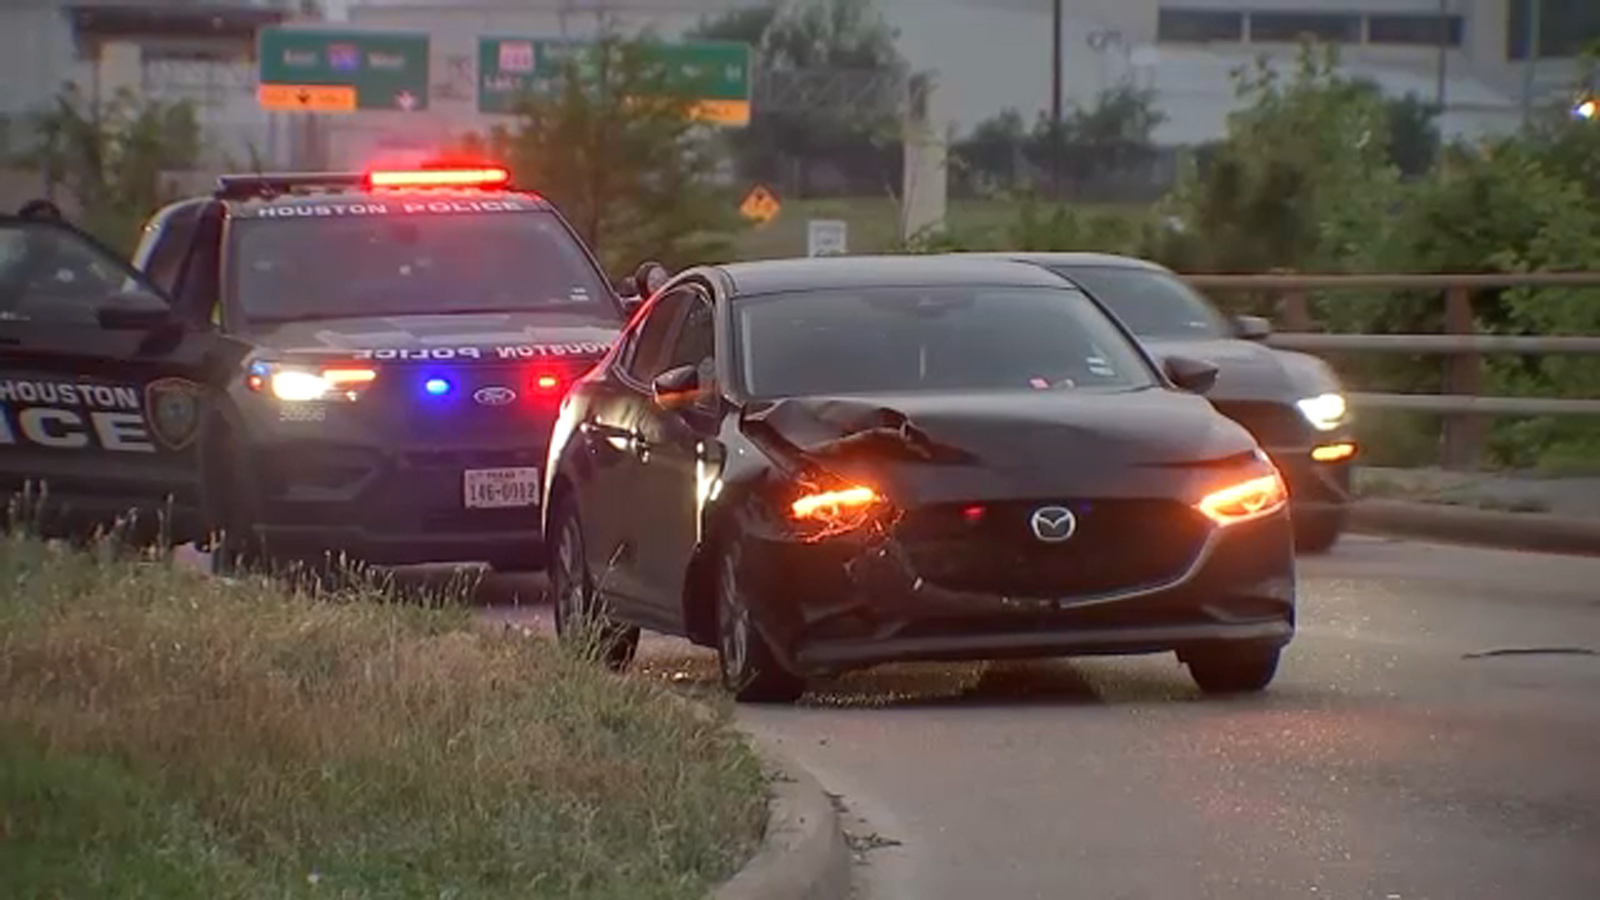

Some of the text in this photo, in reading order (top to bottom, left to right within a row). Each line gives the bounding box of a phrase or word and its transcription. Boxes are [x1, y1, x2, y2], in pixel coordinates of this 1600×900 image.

[258, 201, 524, 217] HOUSTON POLICE
[0, 380, 141, 408] HOUSTON
